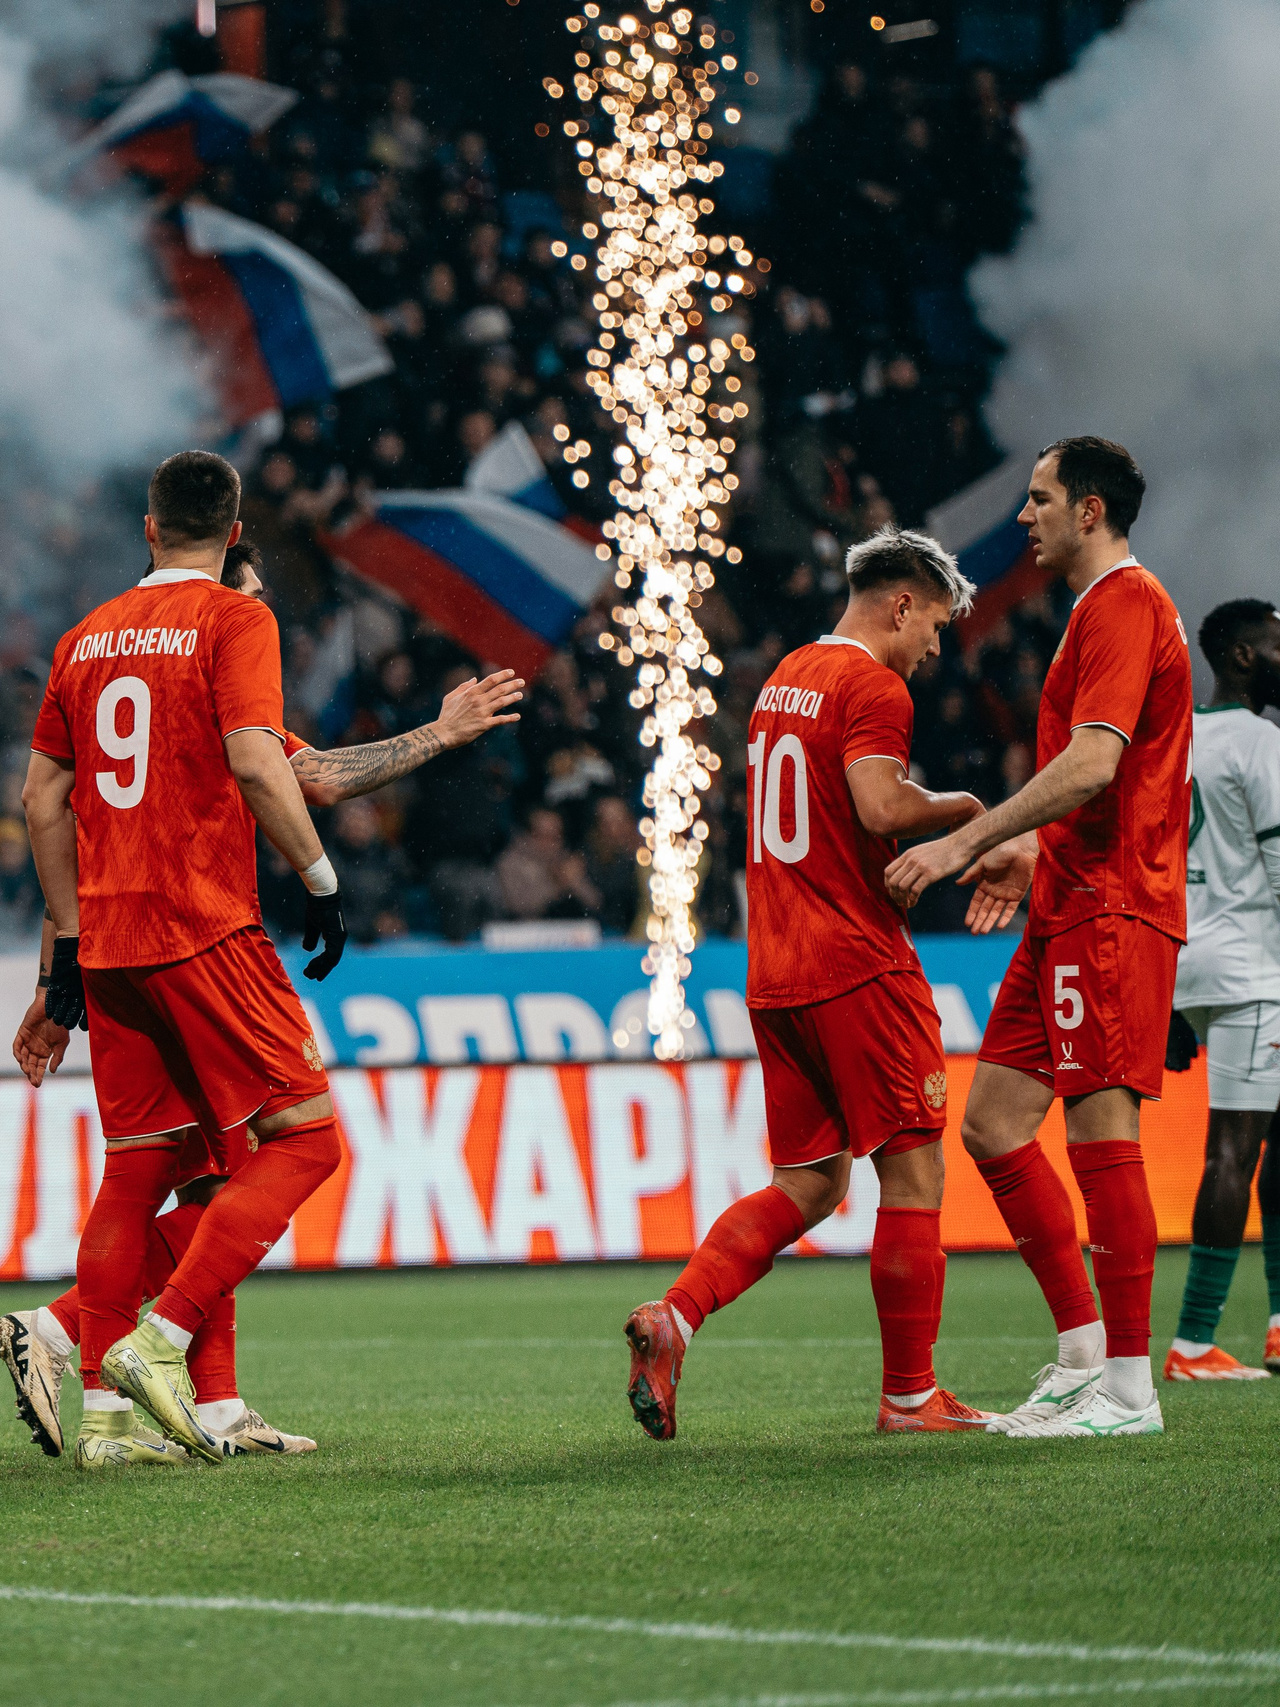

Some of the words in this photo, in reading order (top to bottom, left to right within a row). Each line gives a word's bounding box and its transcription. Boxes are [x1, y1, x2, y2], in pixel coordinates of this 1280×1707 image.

[95, 675, 152, 809] 9
[747, 731, 810, 864] 10
[1054, 965, 1085, 1030] 5
